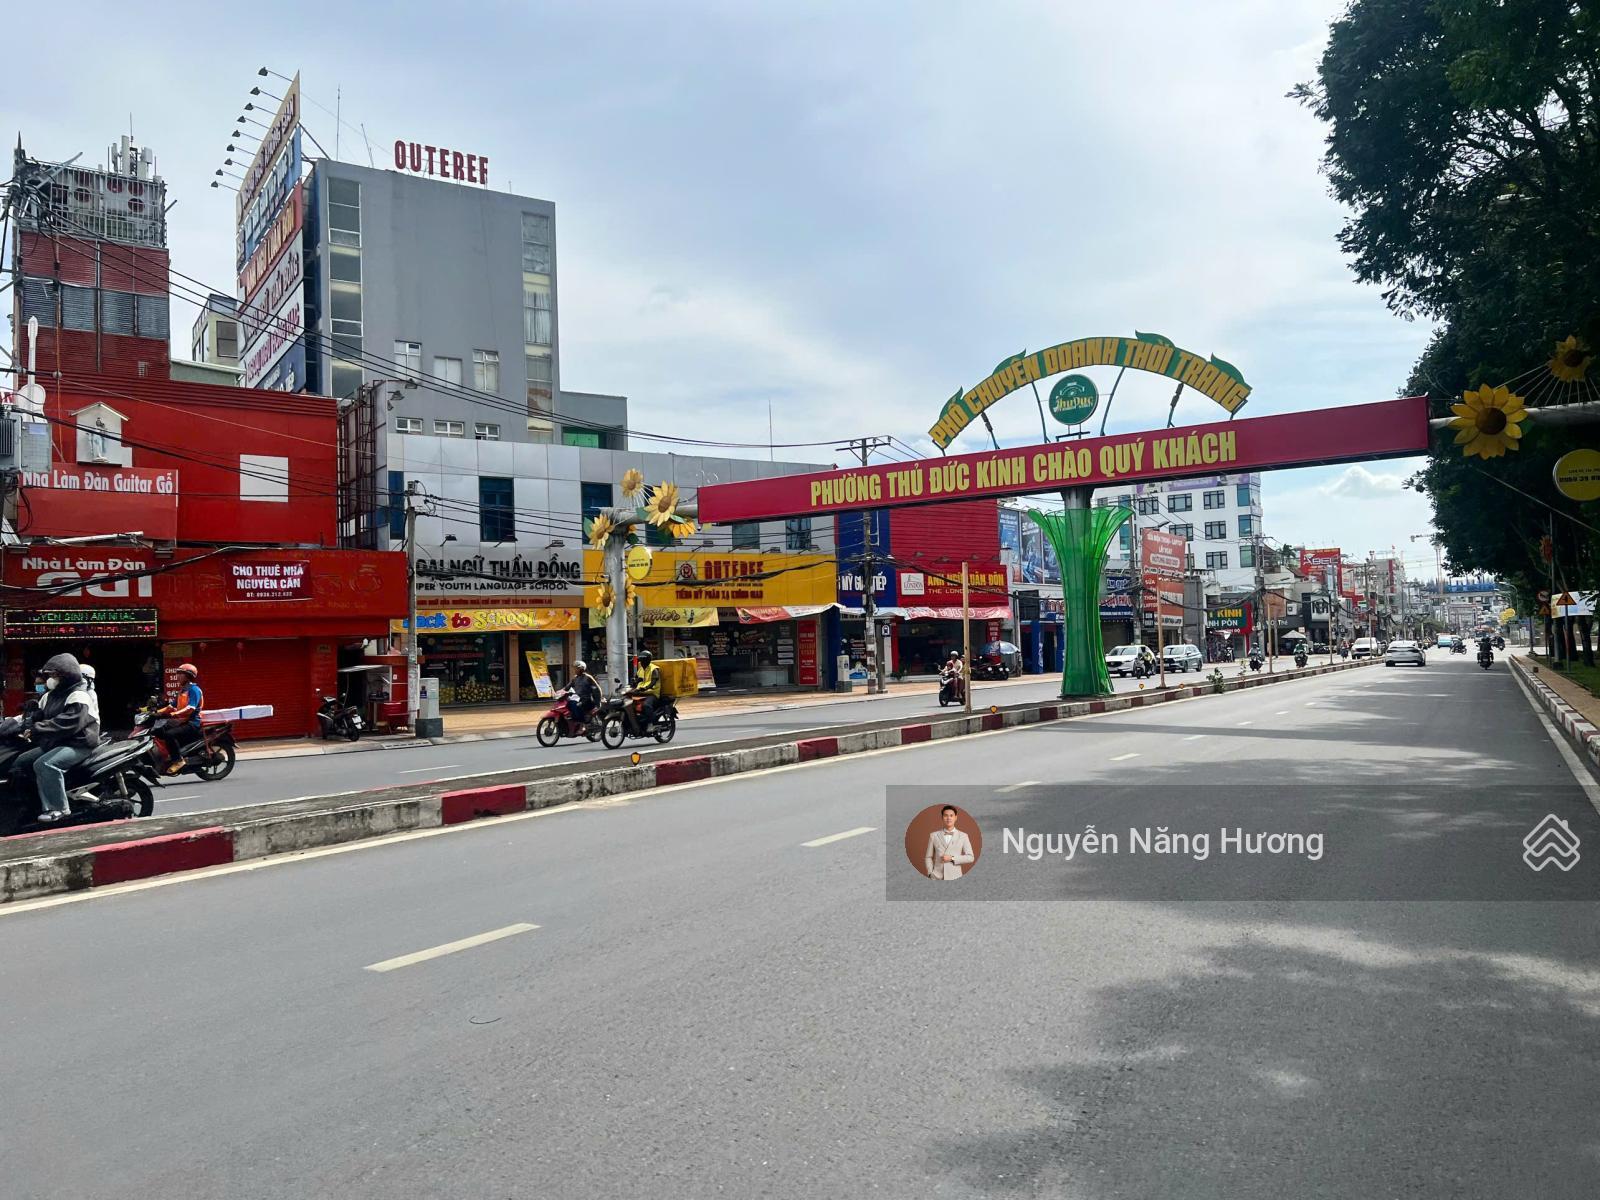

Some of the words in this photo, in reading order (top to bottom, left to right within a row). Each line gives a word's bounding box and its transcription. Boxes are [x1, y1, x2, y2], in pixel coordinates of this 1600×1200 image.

[395, 140, 488, 184] OUTEREF
[929, 397, 968, 447] PHỐ
[964, 354, 1041, 414] CHUYÊN
[1044, 338, 1119, 374] DOANH
[1173, 351, 1250, 412] TRANG
[811, 473, 881, 506] PHƯỜNG
[887, 463, 923, 498] THỦ
[929, 460, 970, 494] ĐỨC
[976, 455, 1025, 489] KÍNH
[1033, 447, 1092, 482] CHÀO
[1100, 437, 1145, 478] QUÝ
[1153, 430, 1236, 469] KHÁCH
[53, 470, 80, 489] Làm
[84, 470, 109, 491] Đàn
[114, 473, 152, 493] Guitar
[156, 472, 173, 495] Gỗ
[22, 557, 61, 570] Nhà
[64, 557, 105, 570] Làm
[107, 558, 146, 570] Đàn
[232, 566, 253, 576] CHO
[255, 564, 281, 576] THUÊ
[489, 553, 532, 578] THẦN
[537, 553, 581, 579] ĐỒNG
[236, 578, 277, 589] NGUYÊN
[280, 578, 301, 588] CĂN
[968, 571, 986, 586] UÂN
[440, 582, 472, 591] YOUTH
[474, 582, 527, 591] LANGUAGE
[451, 613, 471, 628] to
